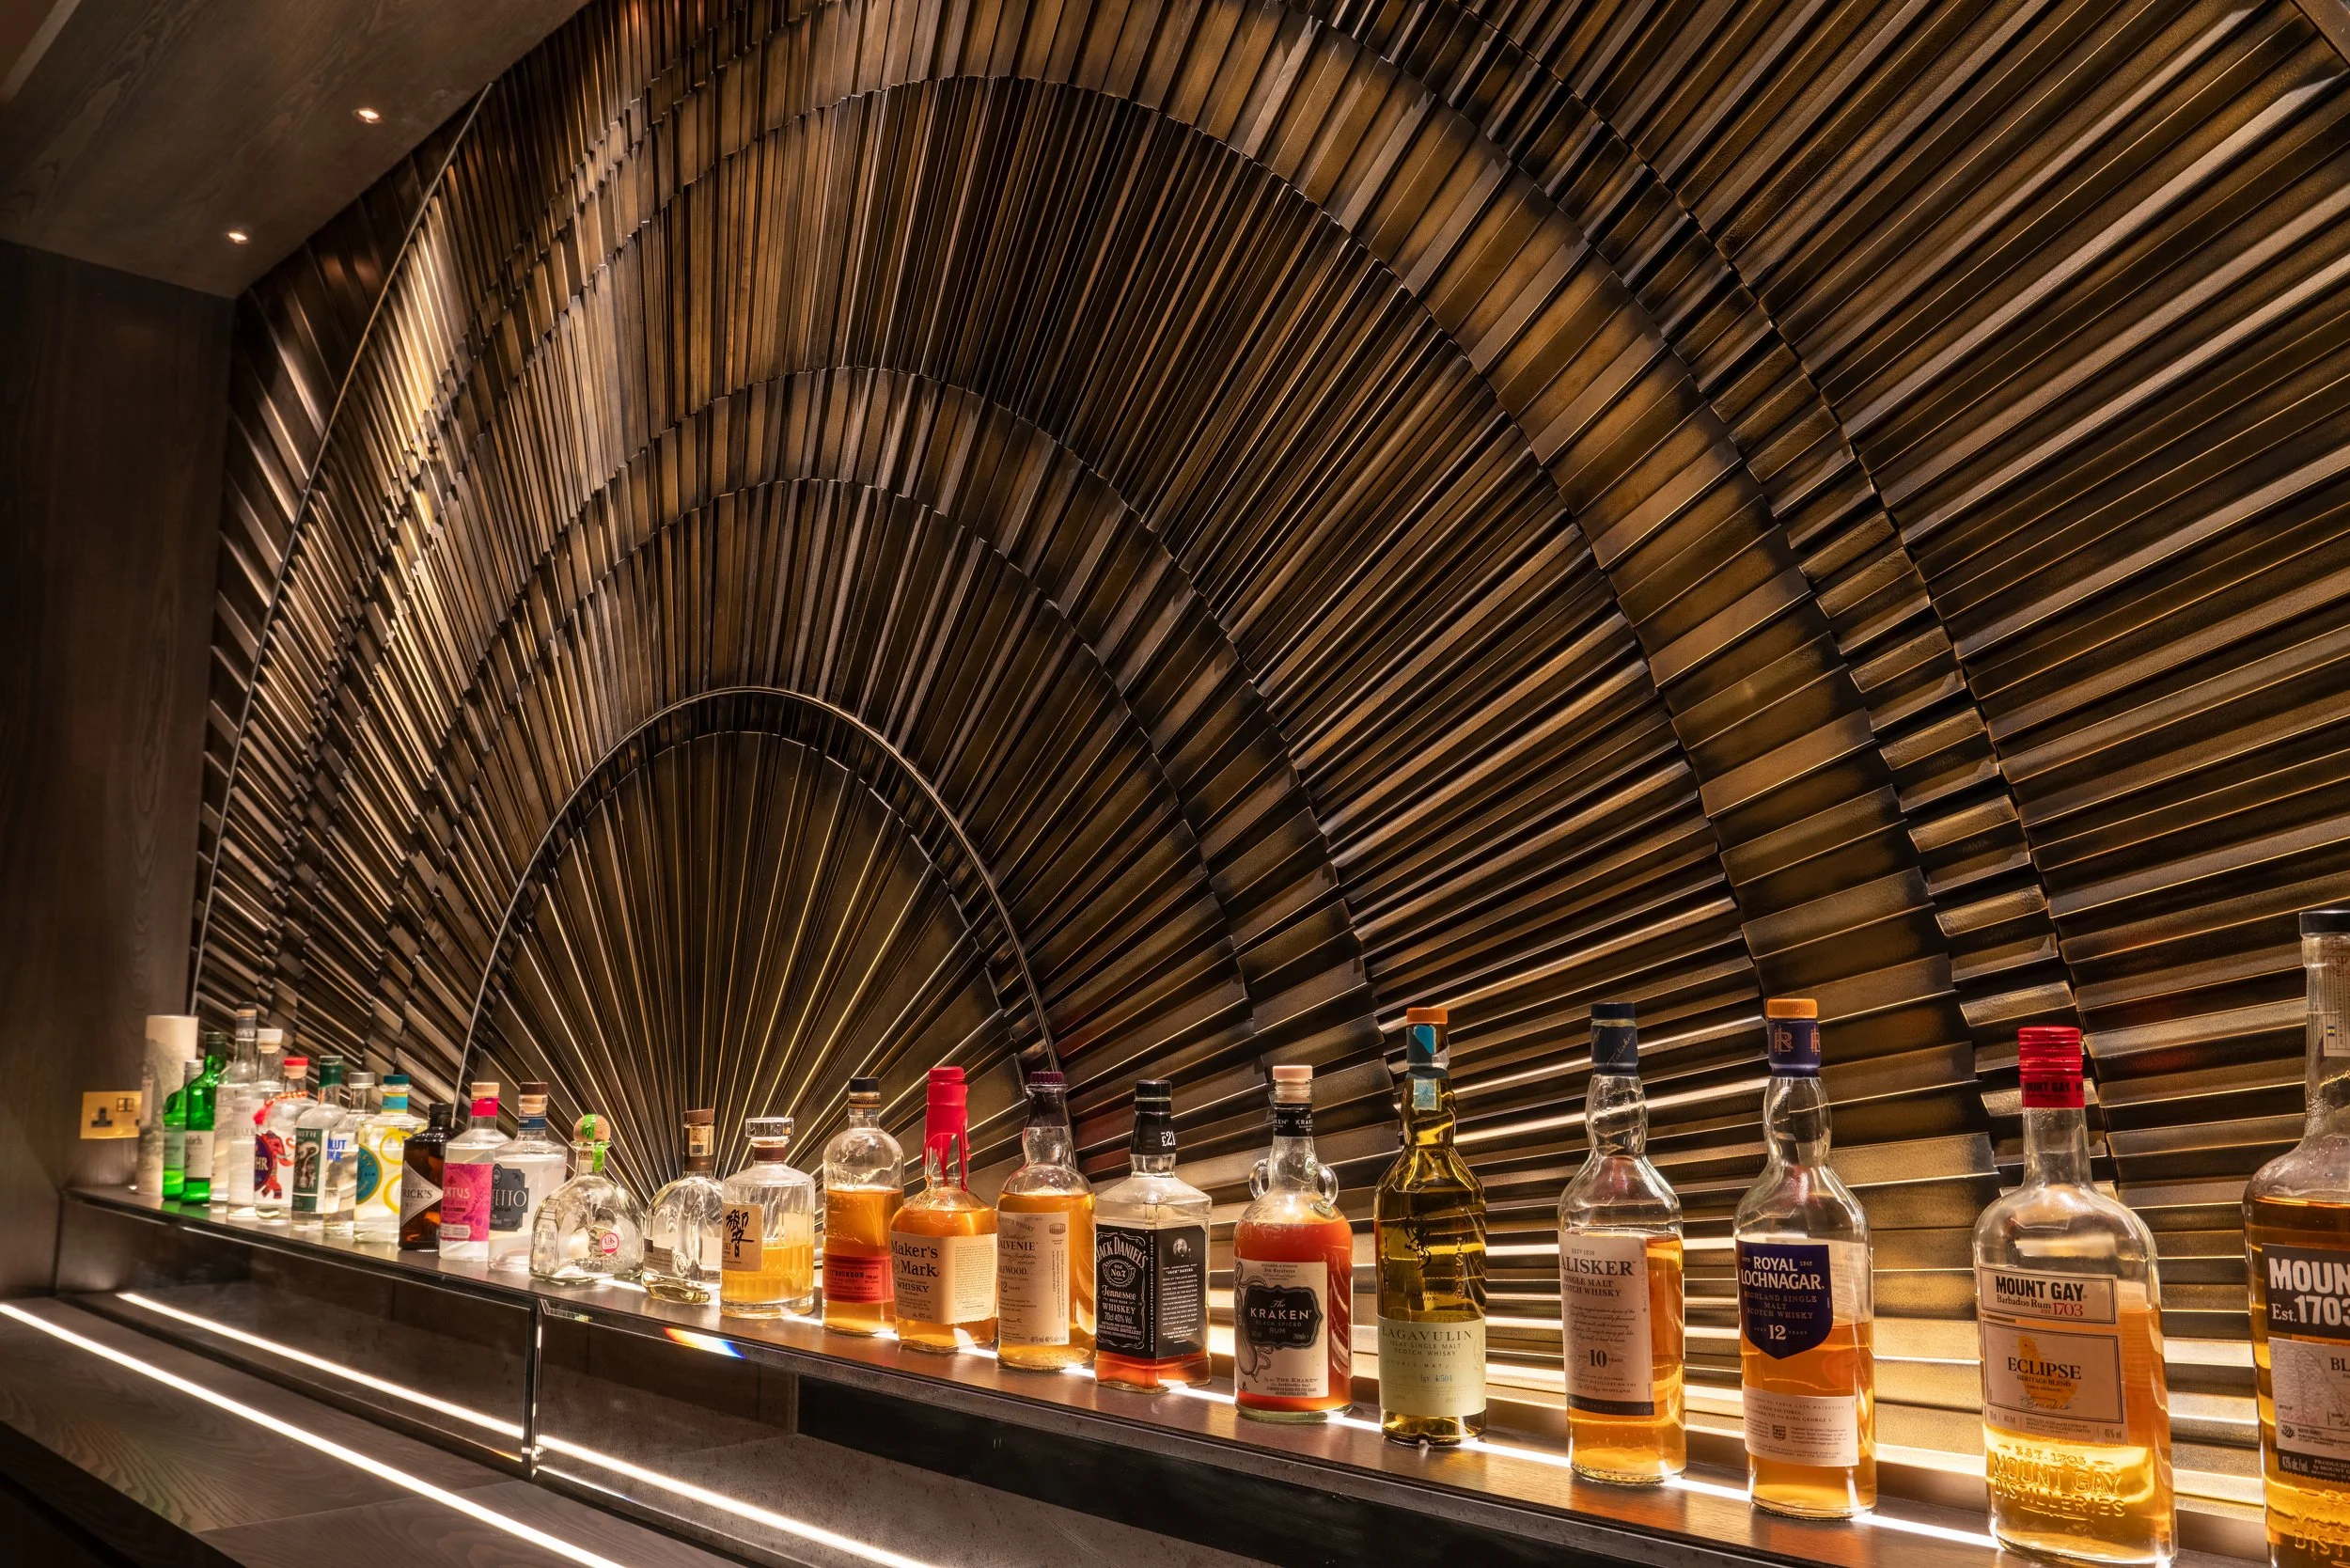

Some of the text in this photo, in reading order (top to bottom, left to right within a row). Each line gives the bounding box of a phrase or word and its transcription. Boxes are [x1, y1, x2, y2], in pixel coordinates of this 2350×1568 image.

[2025, 1082, 2048, 1091] OUNT
[891, 1240, 939, 1260] Maker's
[1096, 1236, 1149, 1269] JACK DANIEL'S
[901, 1260, 940, 1278] Mark
[1561, 1256, 1635, 1276] ALISKER
[1753, 1256, 1798, 1272] ROYAL
[1588, 1278, 1614, 1288] MALT
[1741, 1269, 1824, 1290] LOCHNAGAR
[2268, 1257, 2350, 1295] MOUN
[897, 1281, 931, 1294] WHISKY
[1102, 1284, 1136, 1300] Tennessee
[1584, 1287, 1622, 1297] WHISKY
[1996, 1276, 2084, 1302] MOUNT GAY
[1745, 1291, 1780, 1302] HIGHLAND
[1997, 1294, 2052, 1309] Barbados Rum
[1102, 1302, 1136, 1315] WHISKEY
[1250, 1308, 1309, 1320] KRAKEN
[1747, 1308, 1813, 1319] SCOTCH WHISKY
[1763, 1302, 1787, 1310] MALT
[2052, 1302, 2084, 1317] 1703
[2271, 1303, 2297, 1322] Est.
[1269, 1326, 1286, 1335] RUM
[1382, 1326, 1472, 1341] LAGAVULIN
[1768, 1324, 1787, 1341] 12
[1589, 1350, 1607, 1367] 10
[2007, 1356, 2082, 1380] ECLIPSE
[2016, 1374, 2072, 1388] HERITAGE BLEND
[1993, 1451, 2123, 1497] MOUNT GAY
[1995, 1477, 2125, 1517] DISTILLERIES
